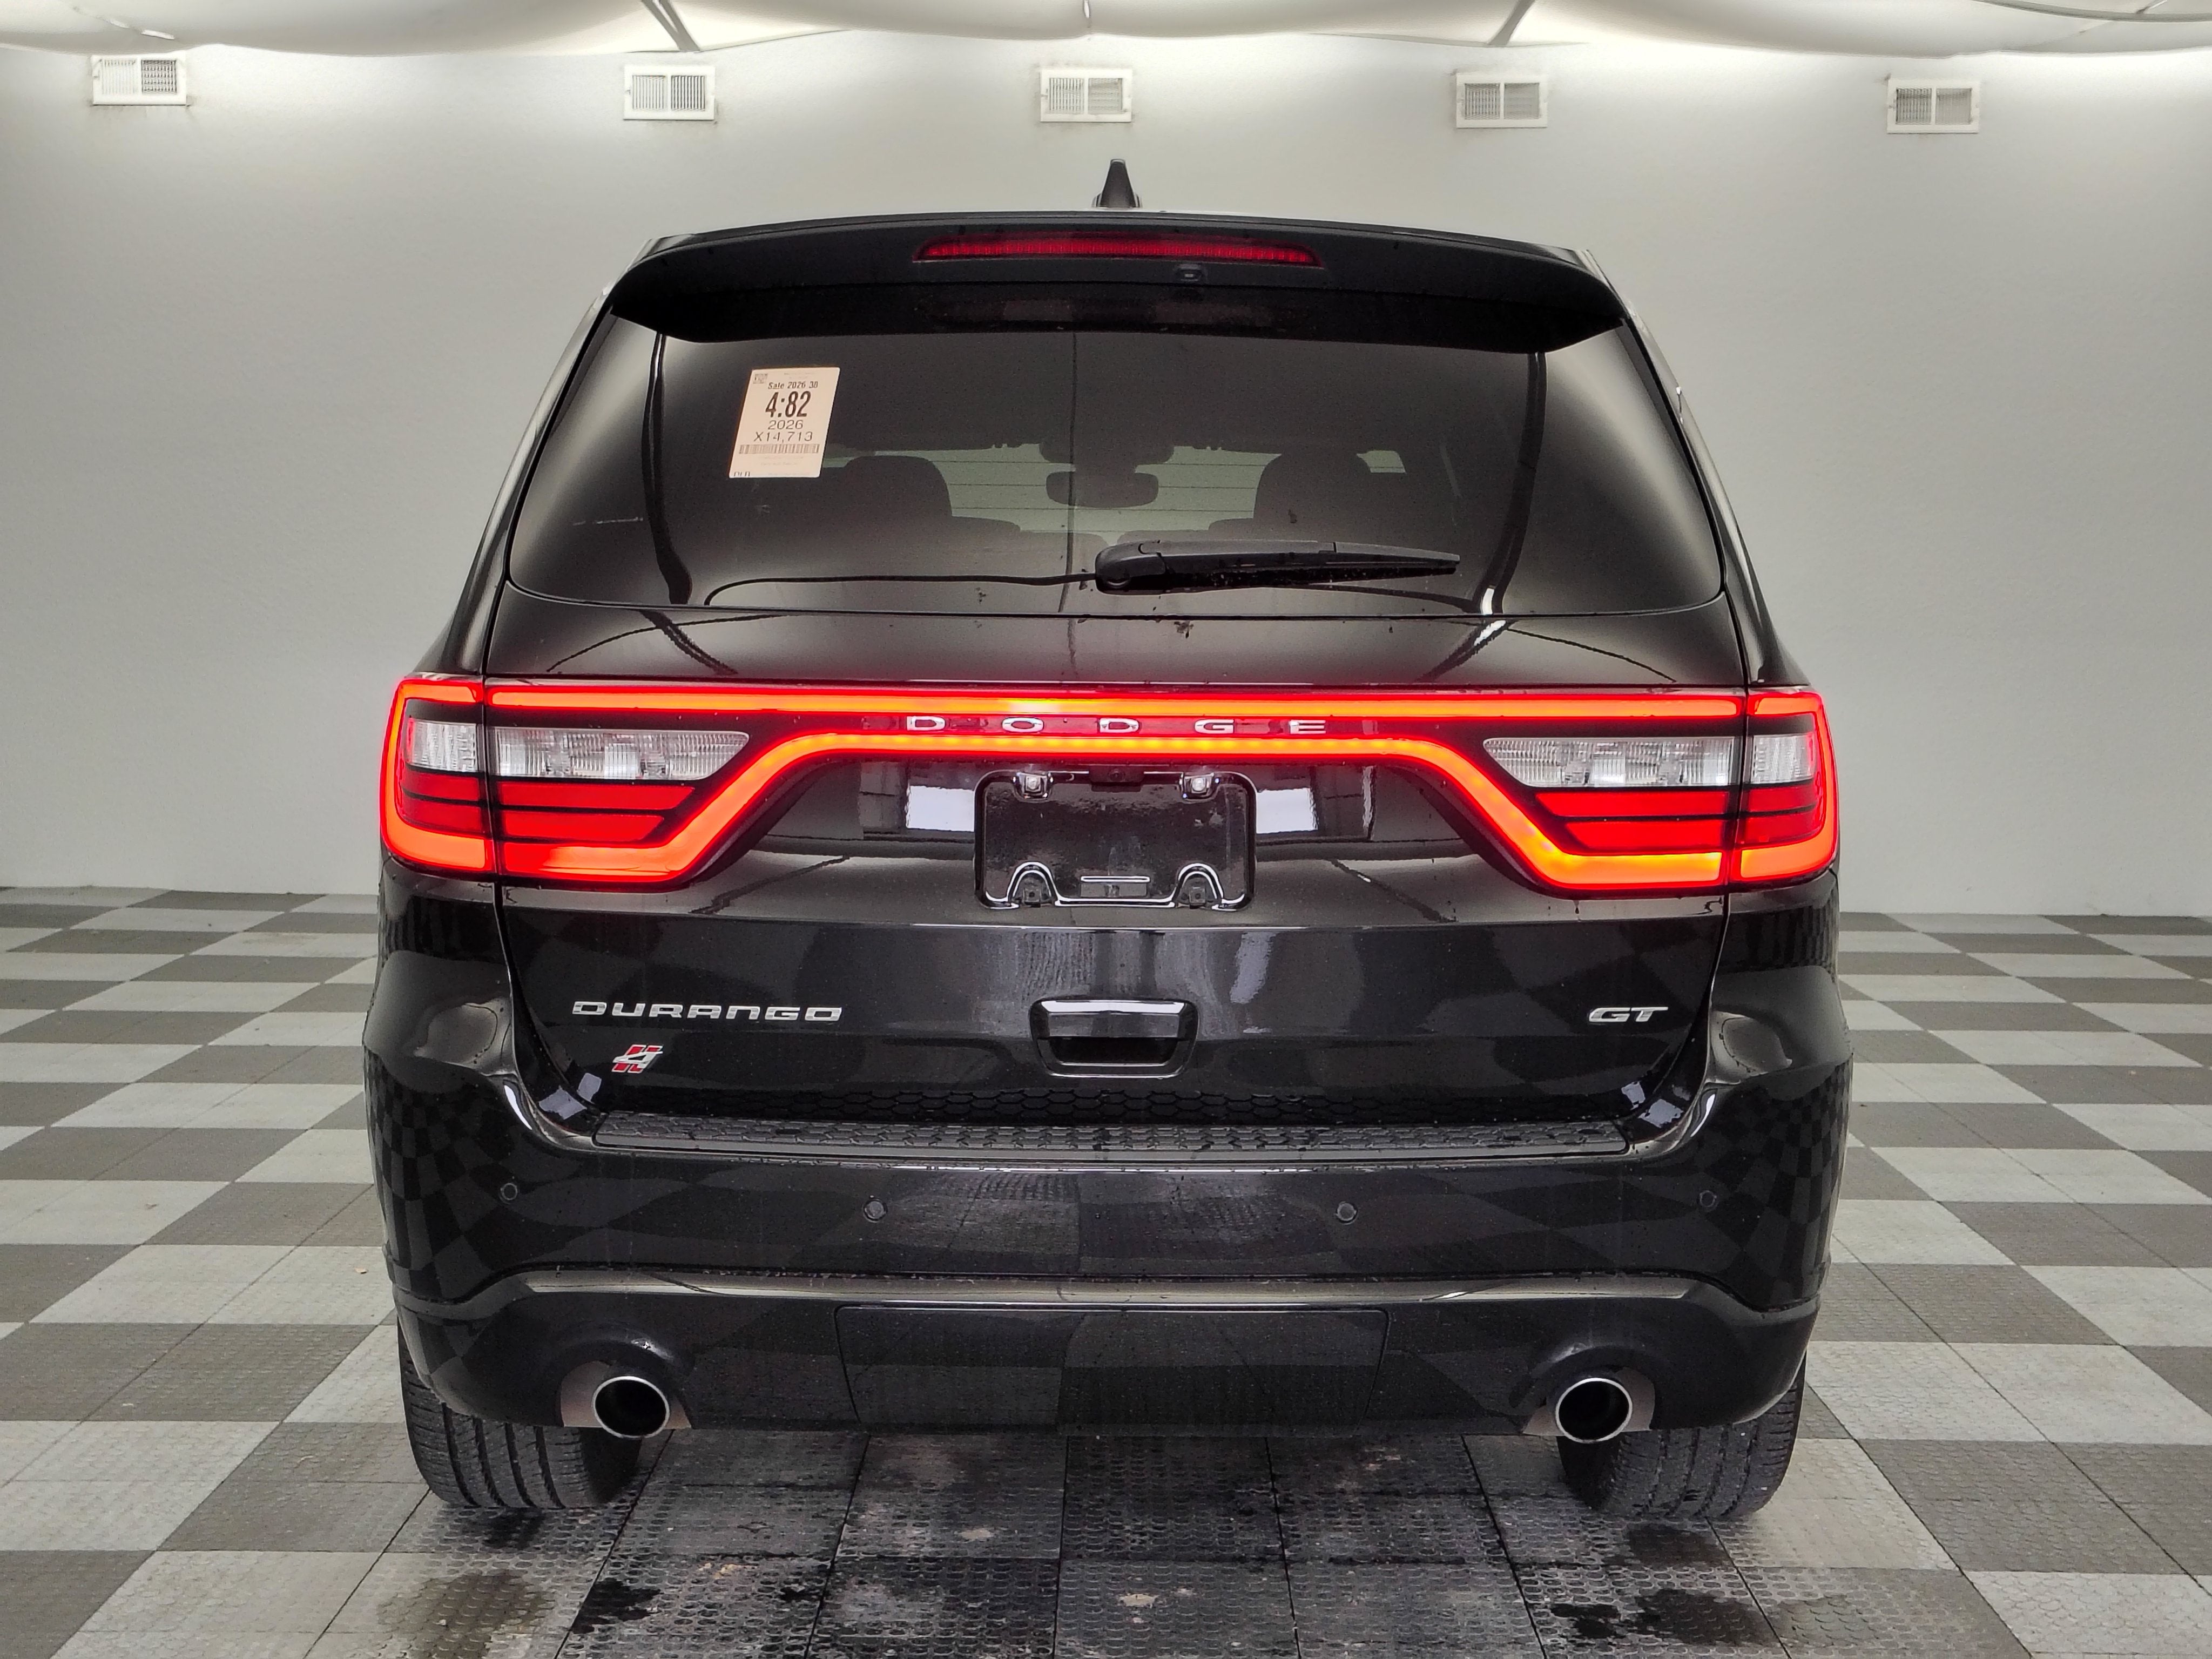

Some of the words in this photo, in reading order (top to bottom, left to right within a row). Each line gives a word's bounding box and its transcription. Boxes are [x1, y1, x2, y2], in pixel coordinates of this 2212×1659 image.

[765, 390, 811, 418] 4:82
[767, 420, 804, 430] 2026
[906, 715, 1326, 735] DODGE
[572, 1001, 842, 1021] DURANGO
[1588, 1006, 1669, 1022] GT
